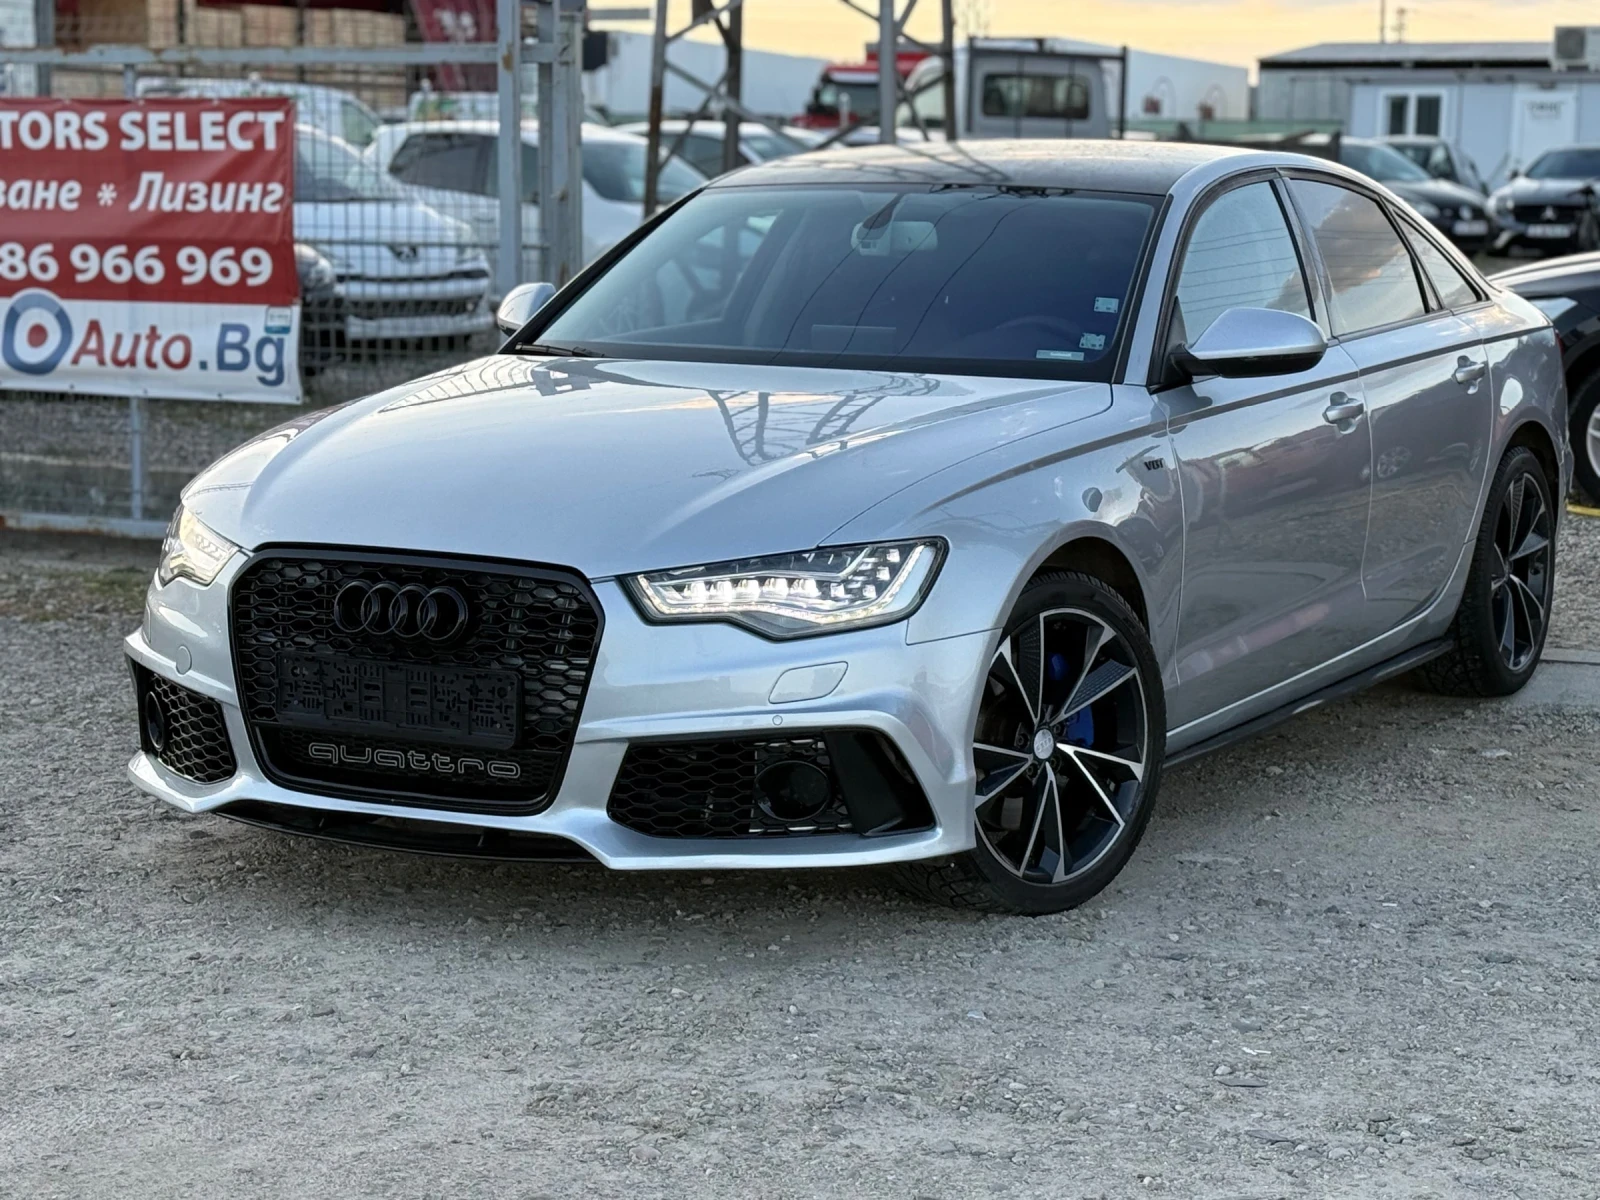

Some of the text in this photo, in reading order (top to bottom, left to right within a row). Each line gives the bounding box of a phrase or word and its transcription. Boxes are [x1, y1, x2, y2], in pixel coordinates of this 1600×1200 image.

[0, 111, 285, 151] TORS SELECT
[129, 172, 284, 213] Лизинг
[0, 242, 273, 287] 86 966 969
[308, 742, 521, 779] quattro
